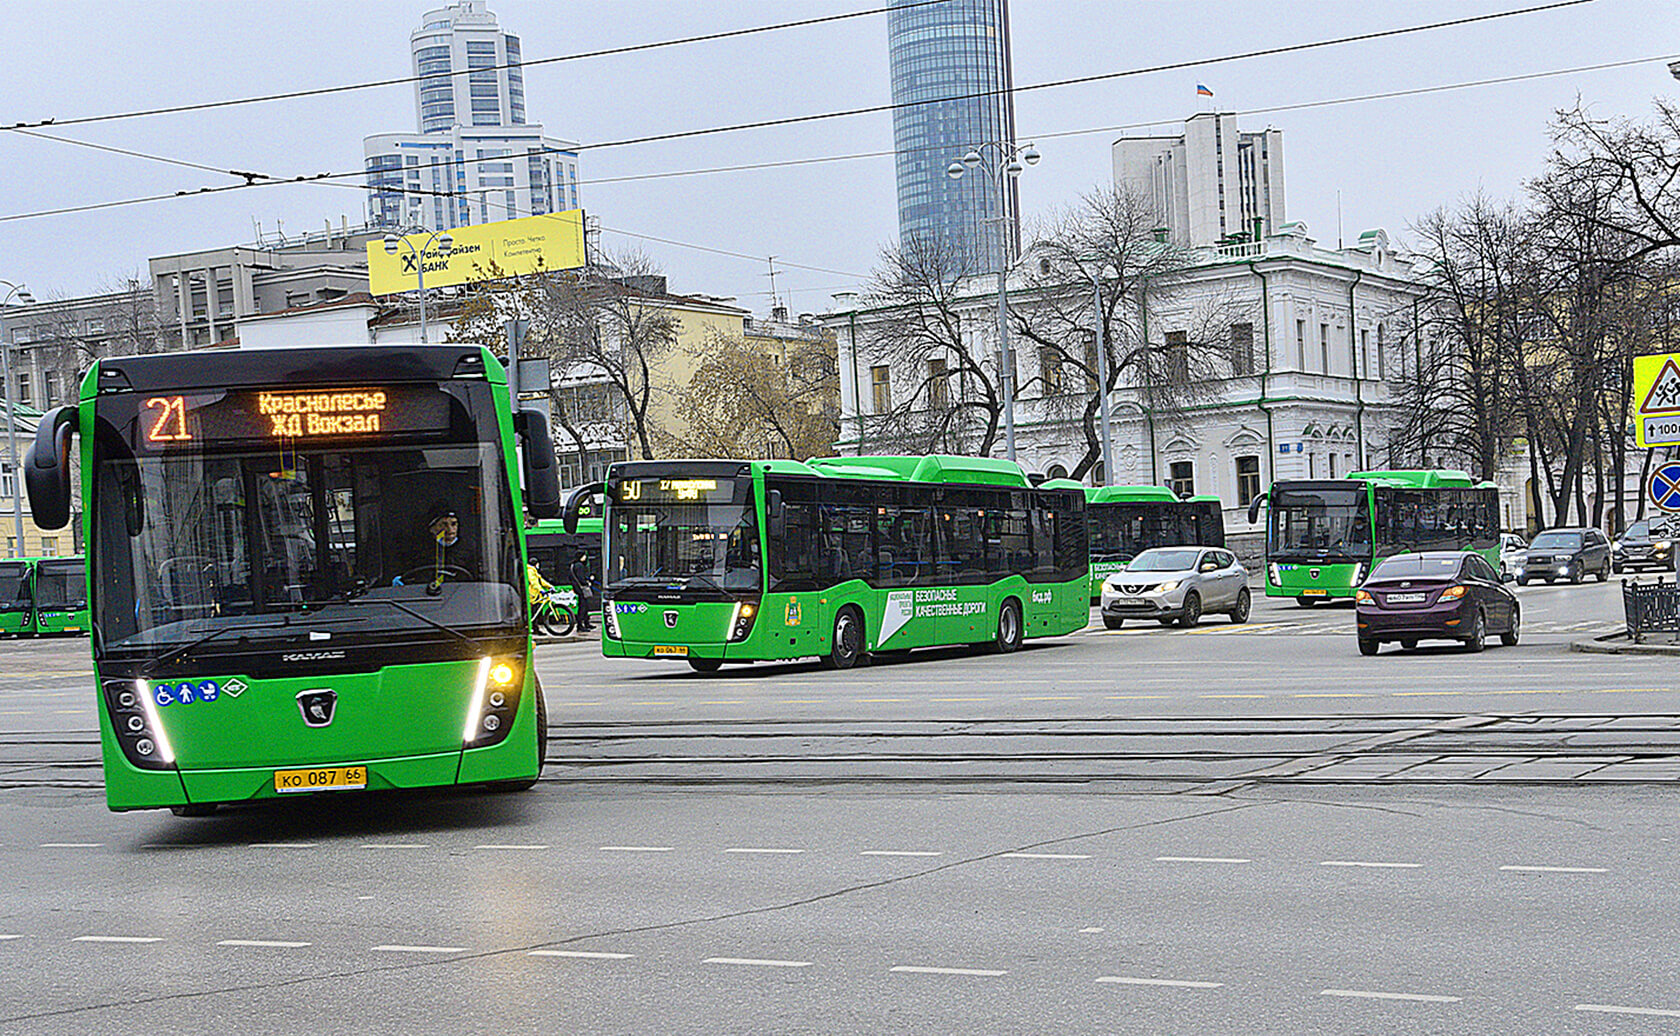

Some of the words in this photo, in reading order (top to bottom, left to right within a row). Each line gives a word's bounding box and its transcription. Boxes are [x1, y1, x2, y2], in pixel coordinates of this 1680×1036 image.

[421, 260, 449, 273] БАНК
[258, 391, 387, 415] Краснолесье
[146, 395, 193, 442] 21
[270, 413, 303, 437] ЖД
[307, 412, 380, 435] Вокзал
[915, 588, 957, 602] БЕЗОПАСНЫЕ
[915, 603, 963, 618] КАЧЕСТВЕННЫЕ
[963, 602, 986, 617] ДОРОГИ
[308, 771, 337, 786] 087
[345, 769, 361, 780] 66
